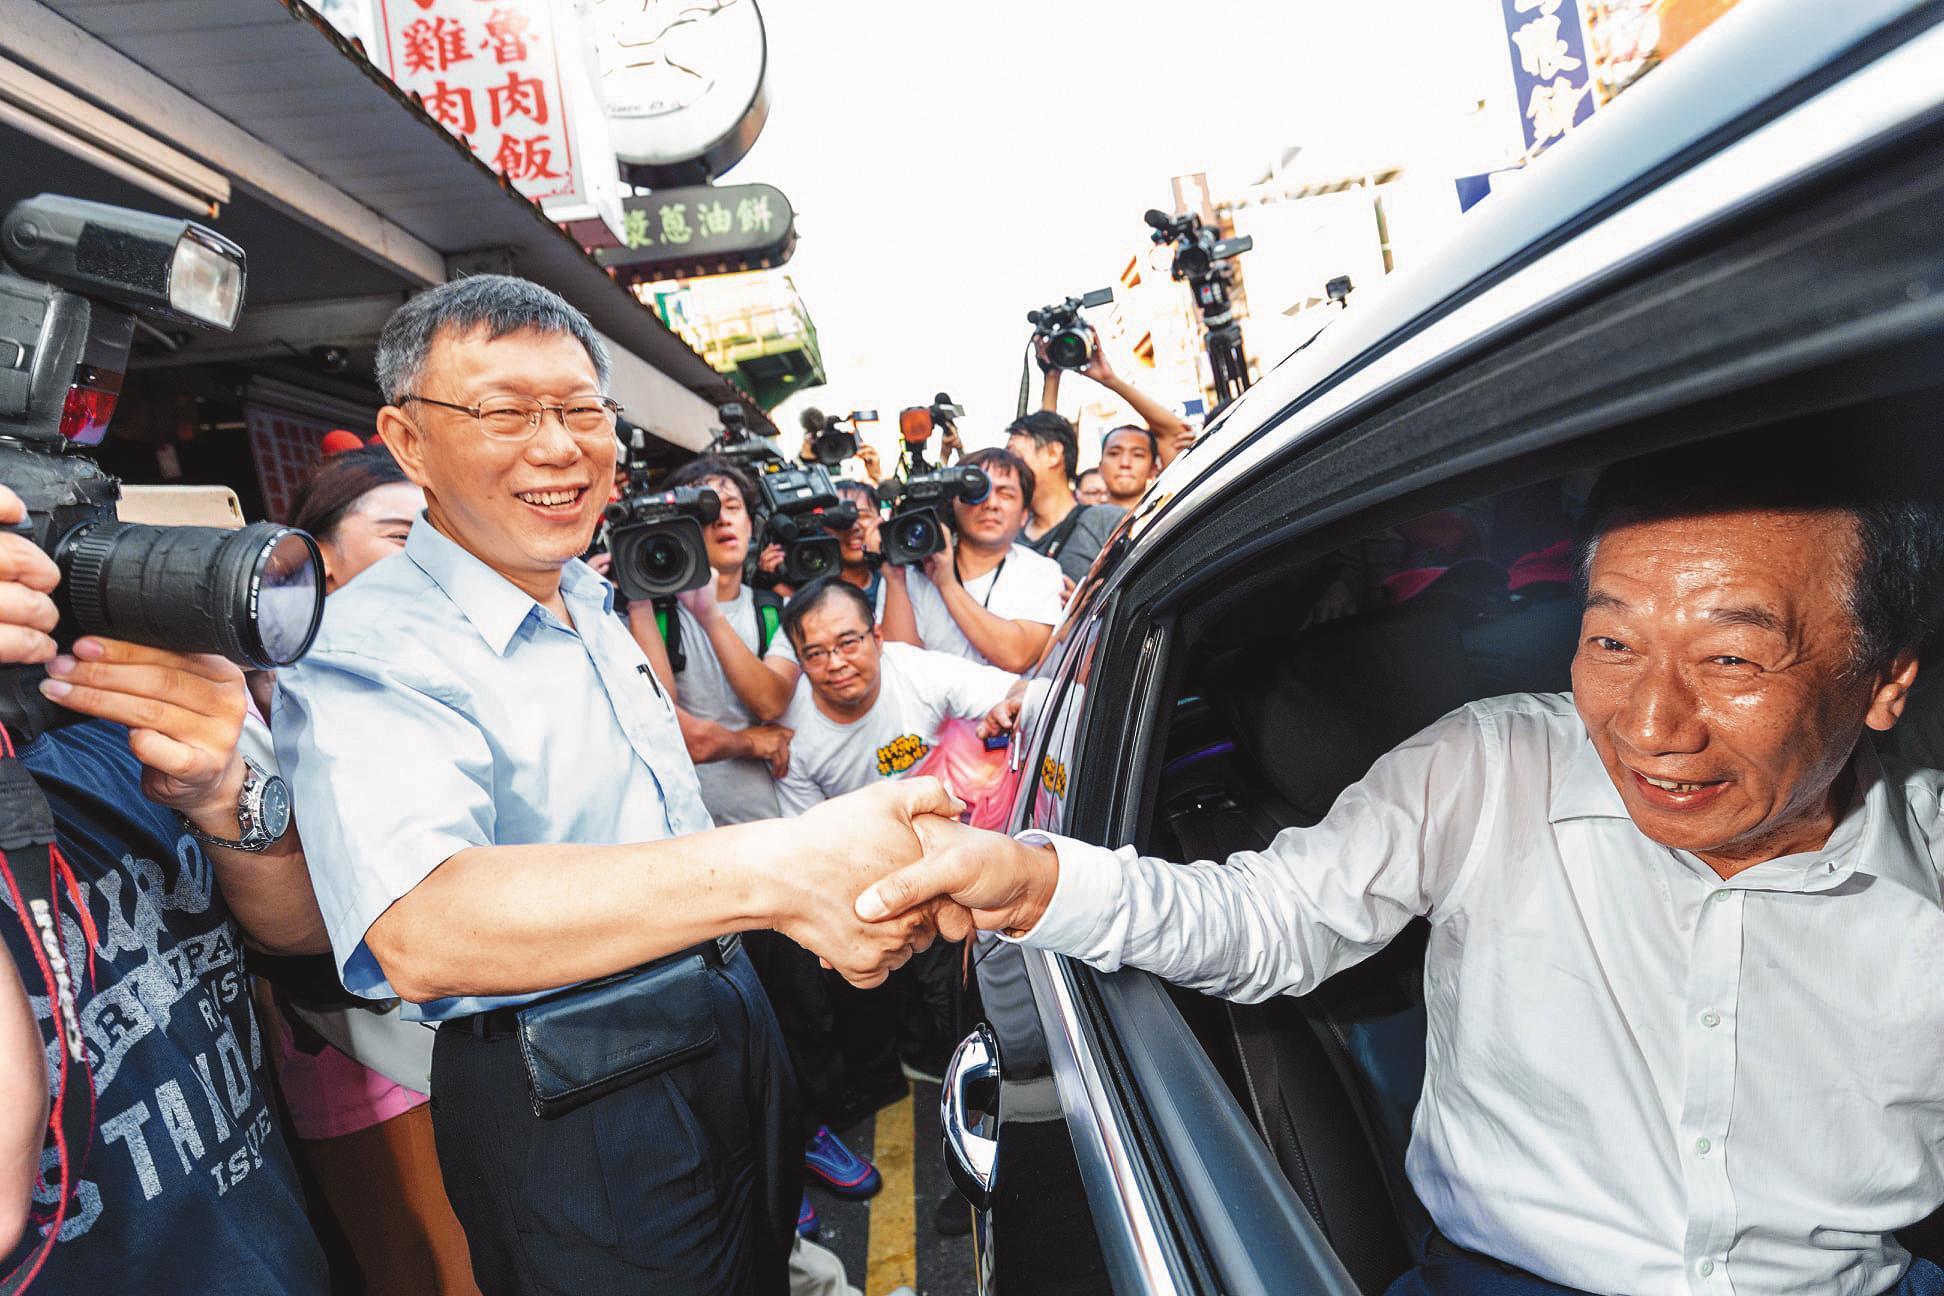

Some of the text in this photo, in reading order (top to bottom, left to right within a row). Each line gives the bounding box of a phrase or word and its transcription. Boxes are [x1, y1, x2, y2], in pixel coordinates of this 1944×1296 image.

[402, 15, 478, 150] 雞肉
[480, 8, 562, 182] 魯肉飯
